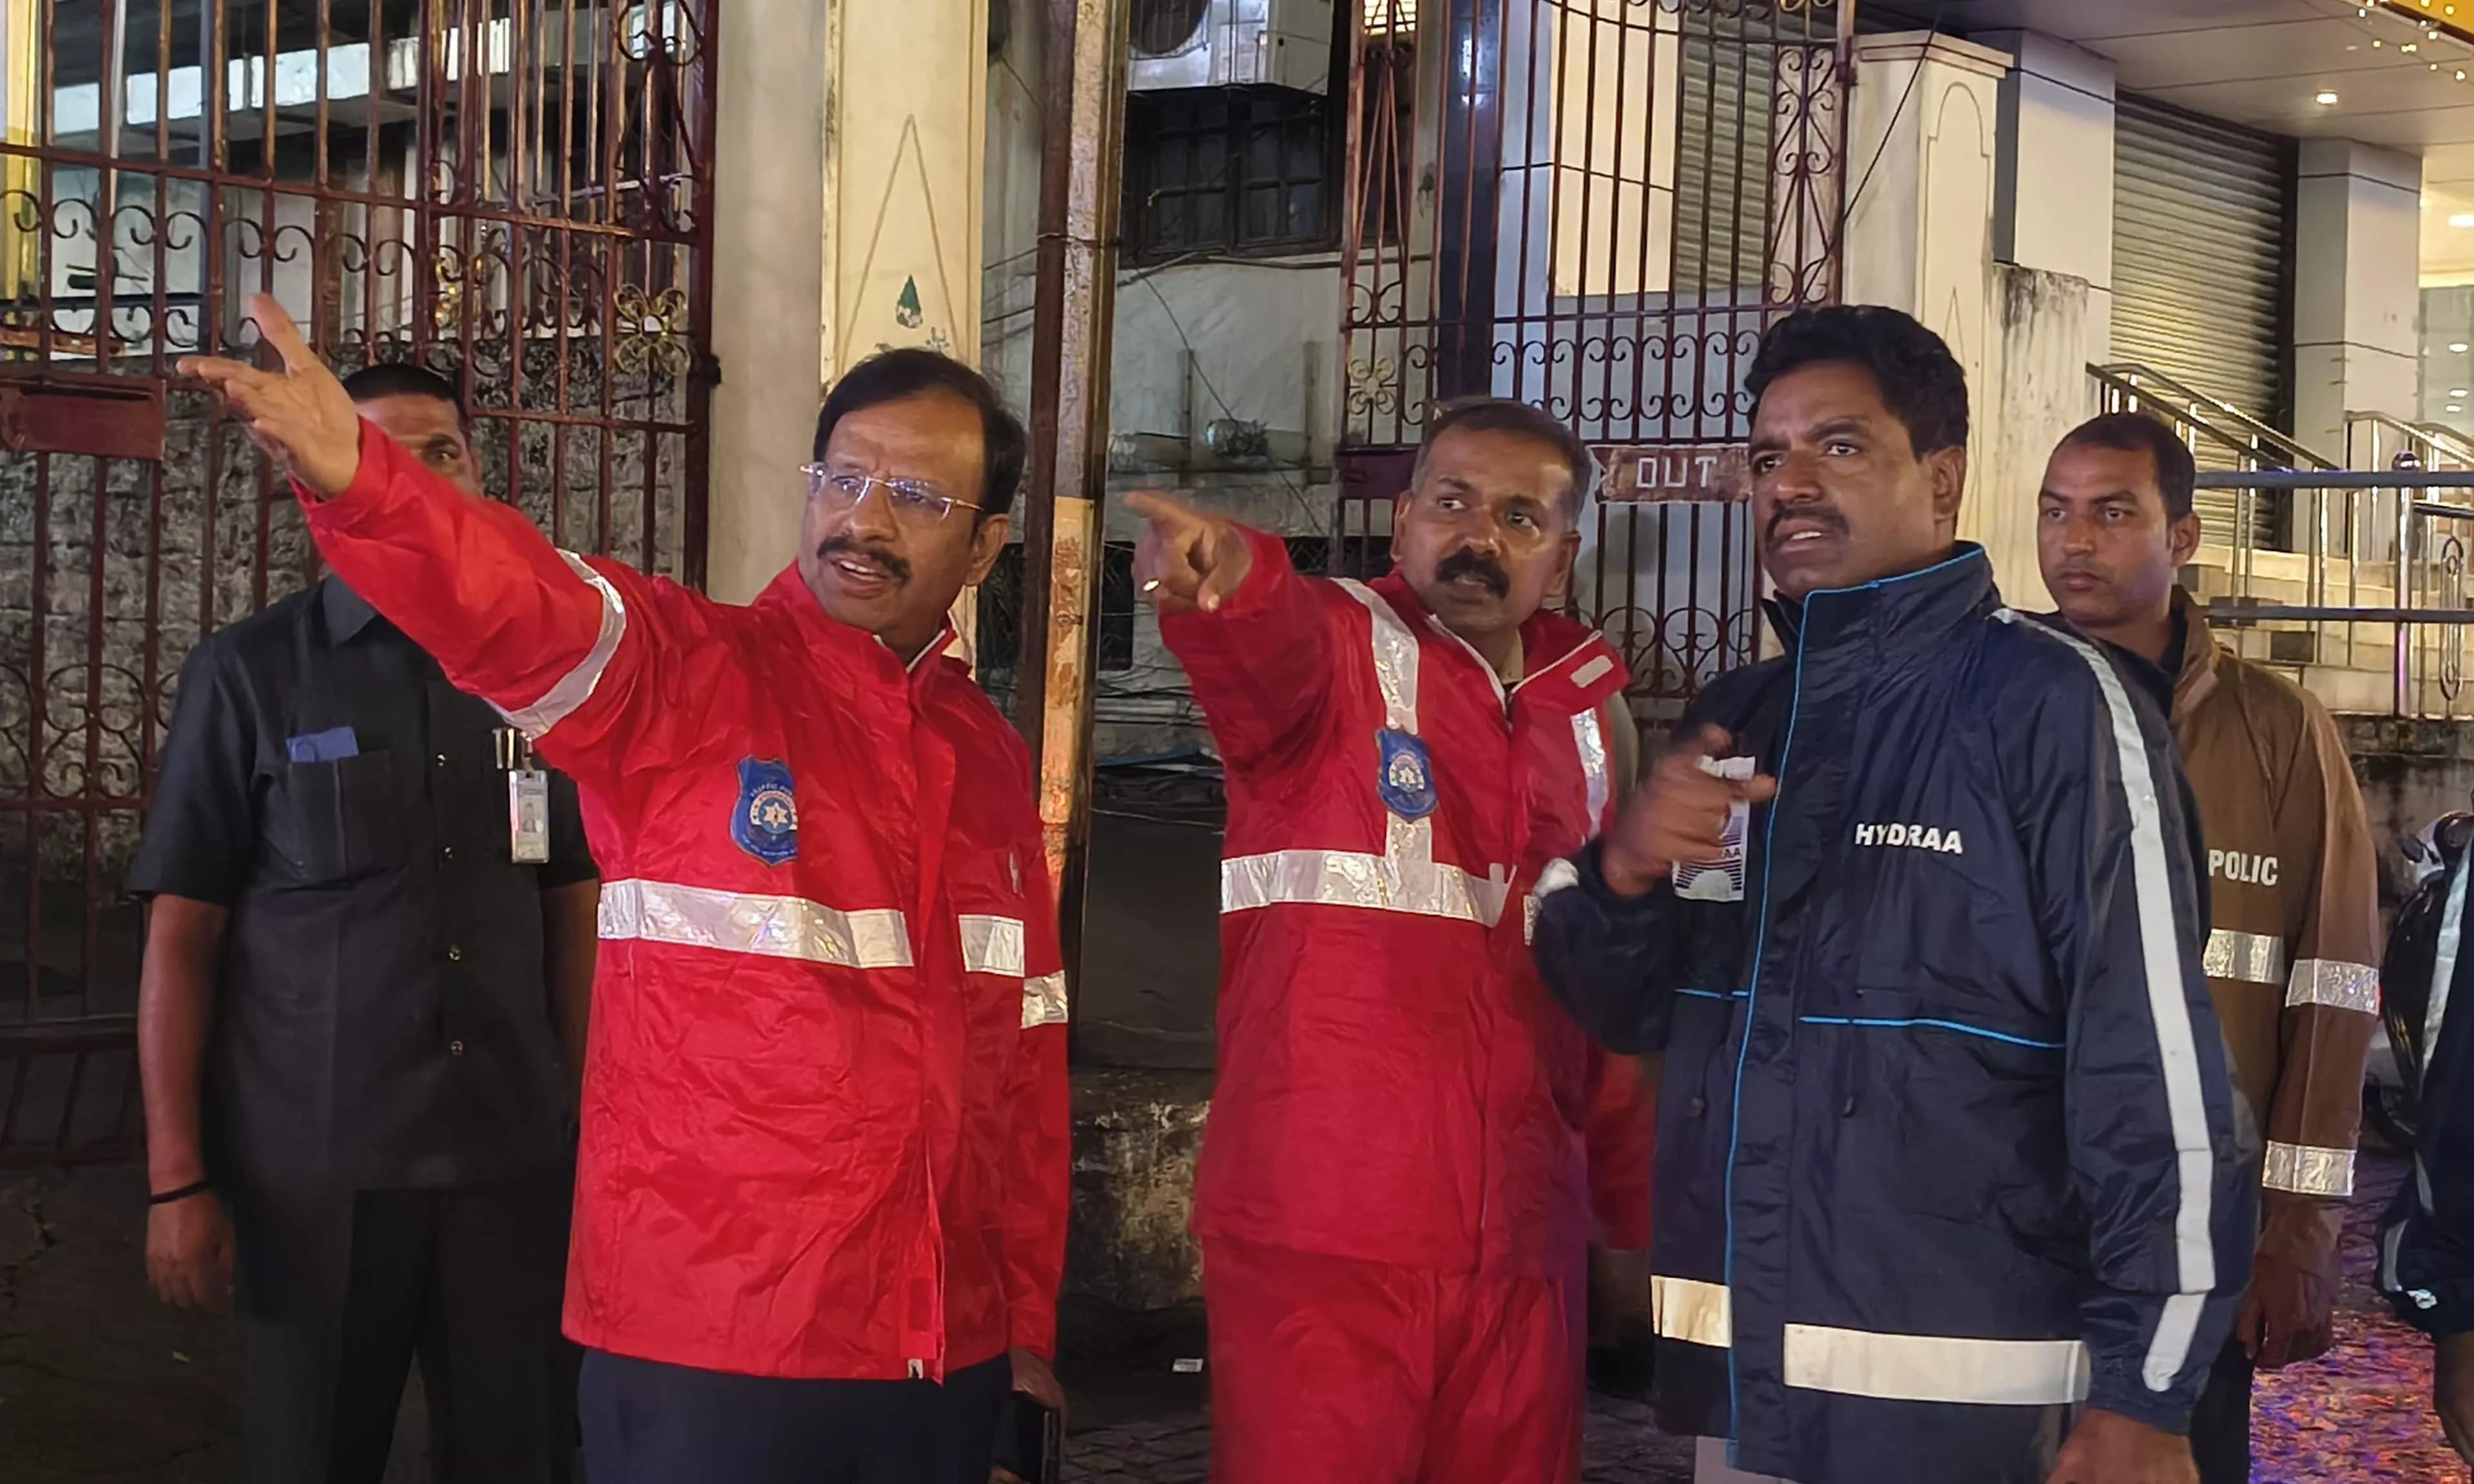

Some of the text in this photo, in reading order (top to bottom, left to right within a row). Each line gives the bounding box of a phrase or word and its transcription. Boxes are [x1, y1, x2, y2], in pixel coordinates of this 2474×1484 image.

[1636, 456, 1717, 488] OUT
[1855, 823, 1963, 854] HYDRAA
[2208, 849, 2278, 886] POLIC
